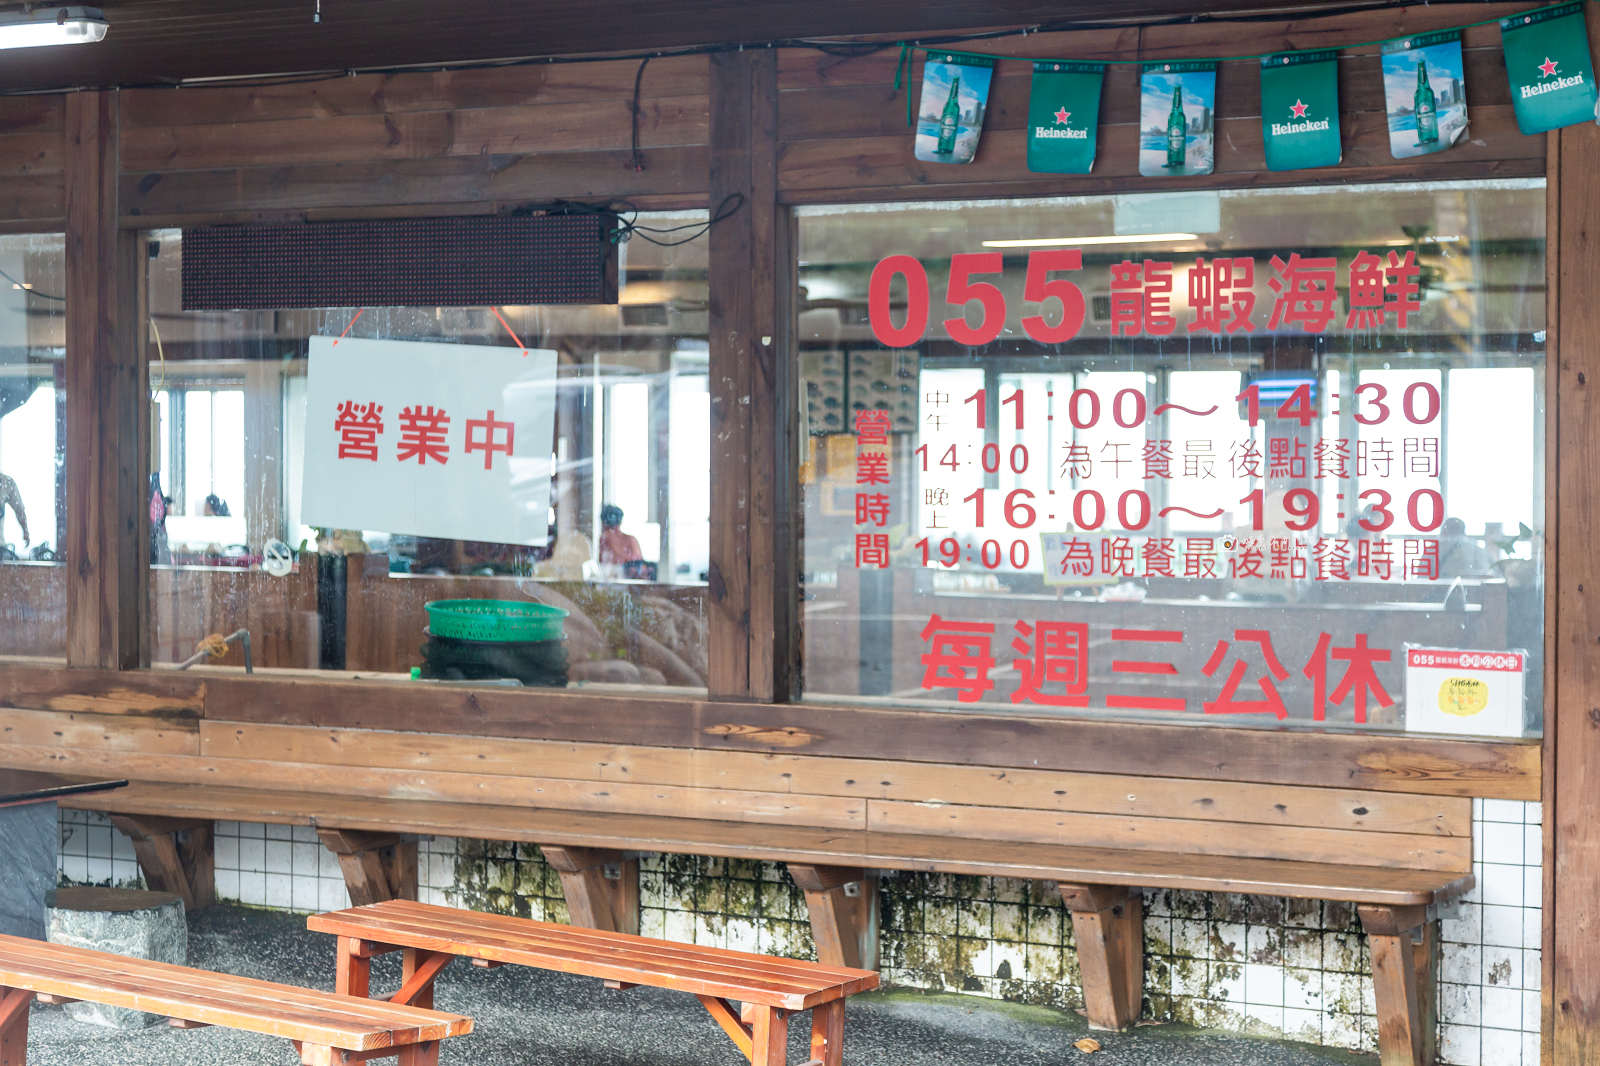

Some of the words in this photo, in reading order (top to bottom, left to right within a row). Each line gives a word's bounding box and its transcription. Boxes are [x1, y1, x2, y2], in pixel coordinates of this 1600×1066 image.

[1520, 74, 1584, 99] Heineken
[1035, 126, 1088, 139] Heineken
[1271, 120, 1330, 136] Heineken
[868, 249, 1086, 348] 055
[1110, 249, 1421, 337] 龍蝦海鮮
[926, 389, 949, 431] 中午
[334, 400, 515, 470] 營業中
[914, 442, 1029, 474] 14:00
[1060, 436, 1440, 480] 為午餐最後點餐時間
[855, 409, 891, 569] 營業時間
[925, 488, 949, 528] 晚上
[914, 537, 1030, 569] 19:00
[1061, 535, 1440, 581] 為晚餐最後點餐時間
[919, 613, 1395, 725] 每週三公休
[1413, 654, 1435, 666] 055
